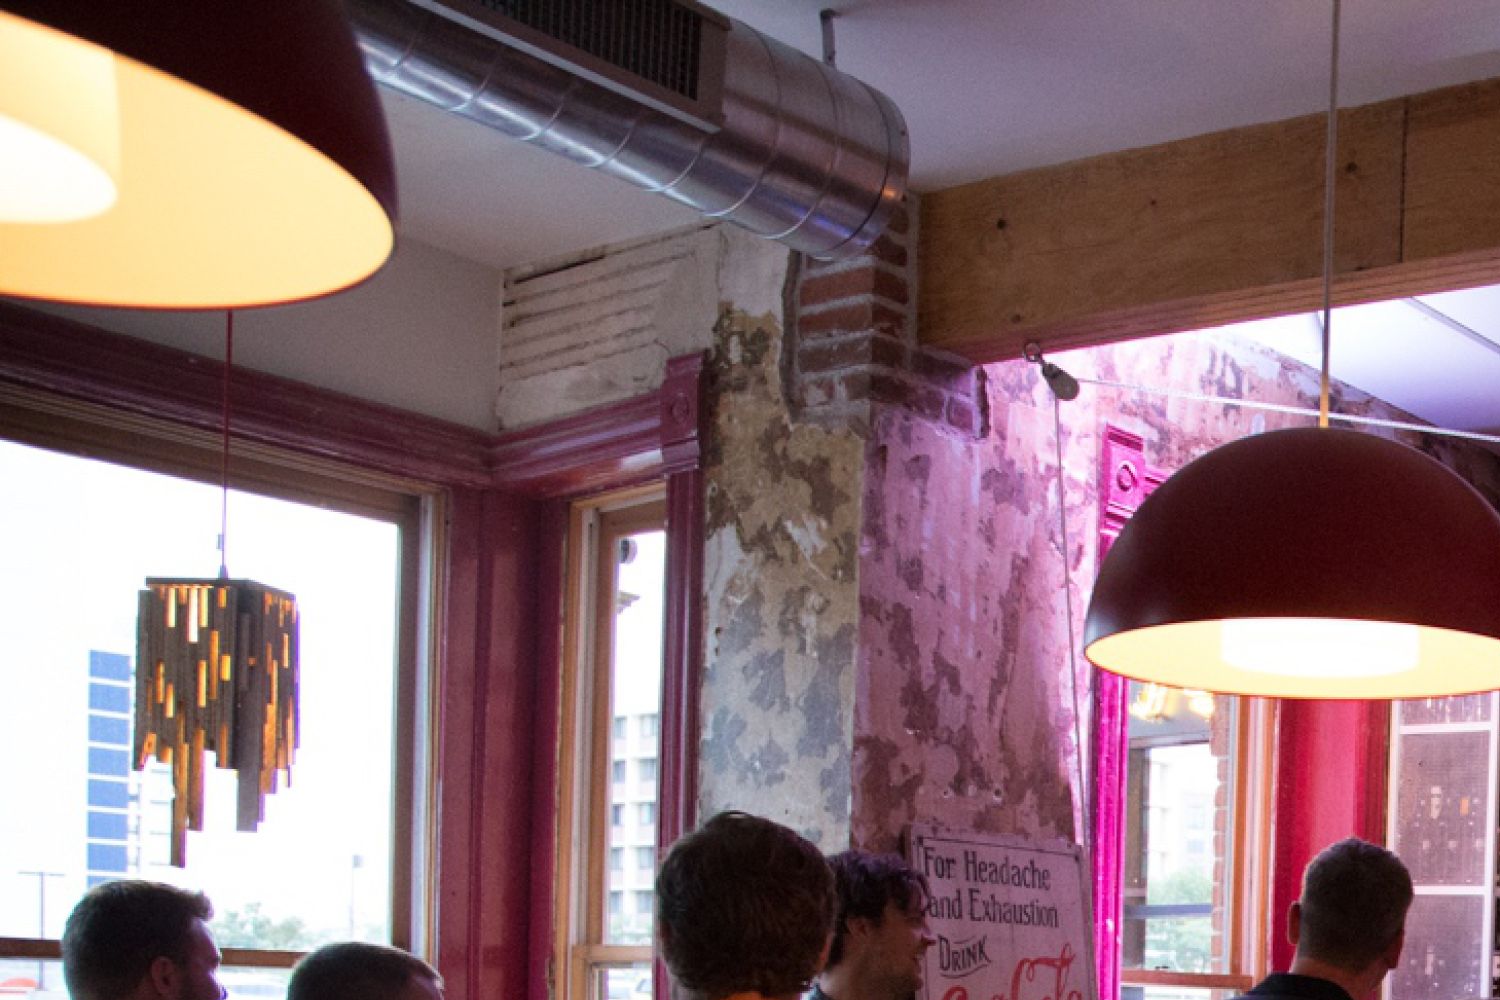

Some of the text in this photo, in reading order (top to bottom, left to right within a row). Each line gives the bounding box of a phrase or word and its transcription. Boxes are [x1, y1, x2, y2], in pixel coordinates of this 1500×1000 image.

[923, 847, 1051, 891] For Headache
[929, 888, 1060, 929] and Exhaustion
[938, 934, 991, 972] DRINK
